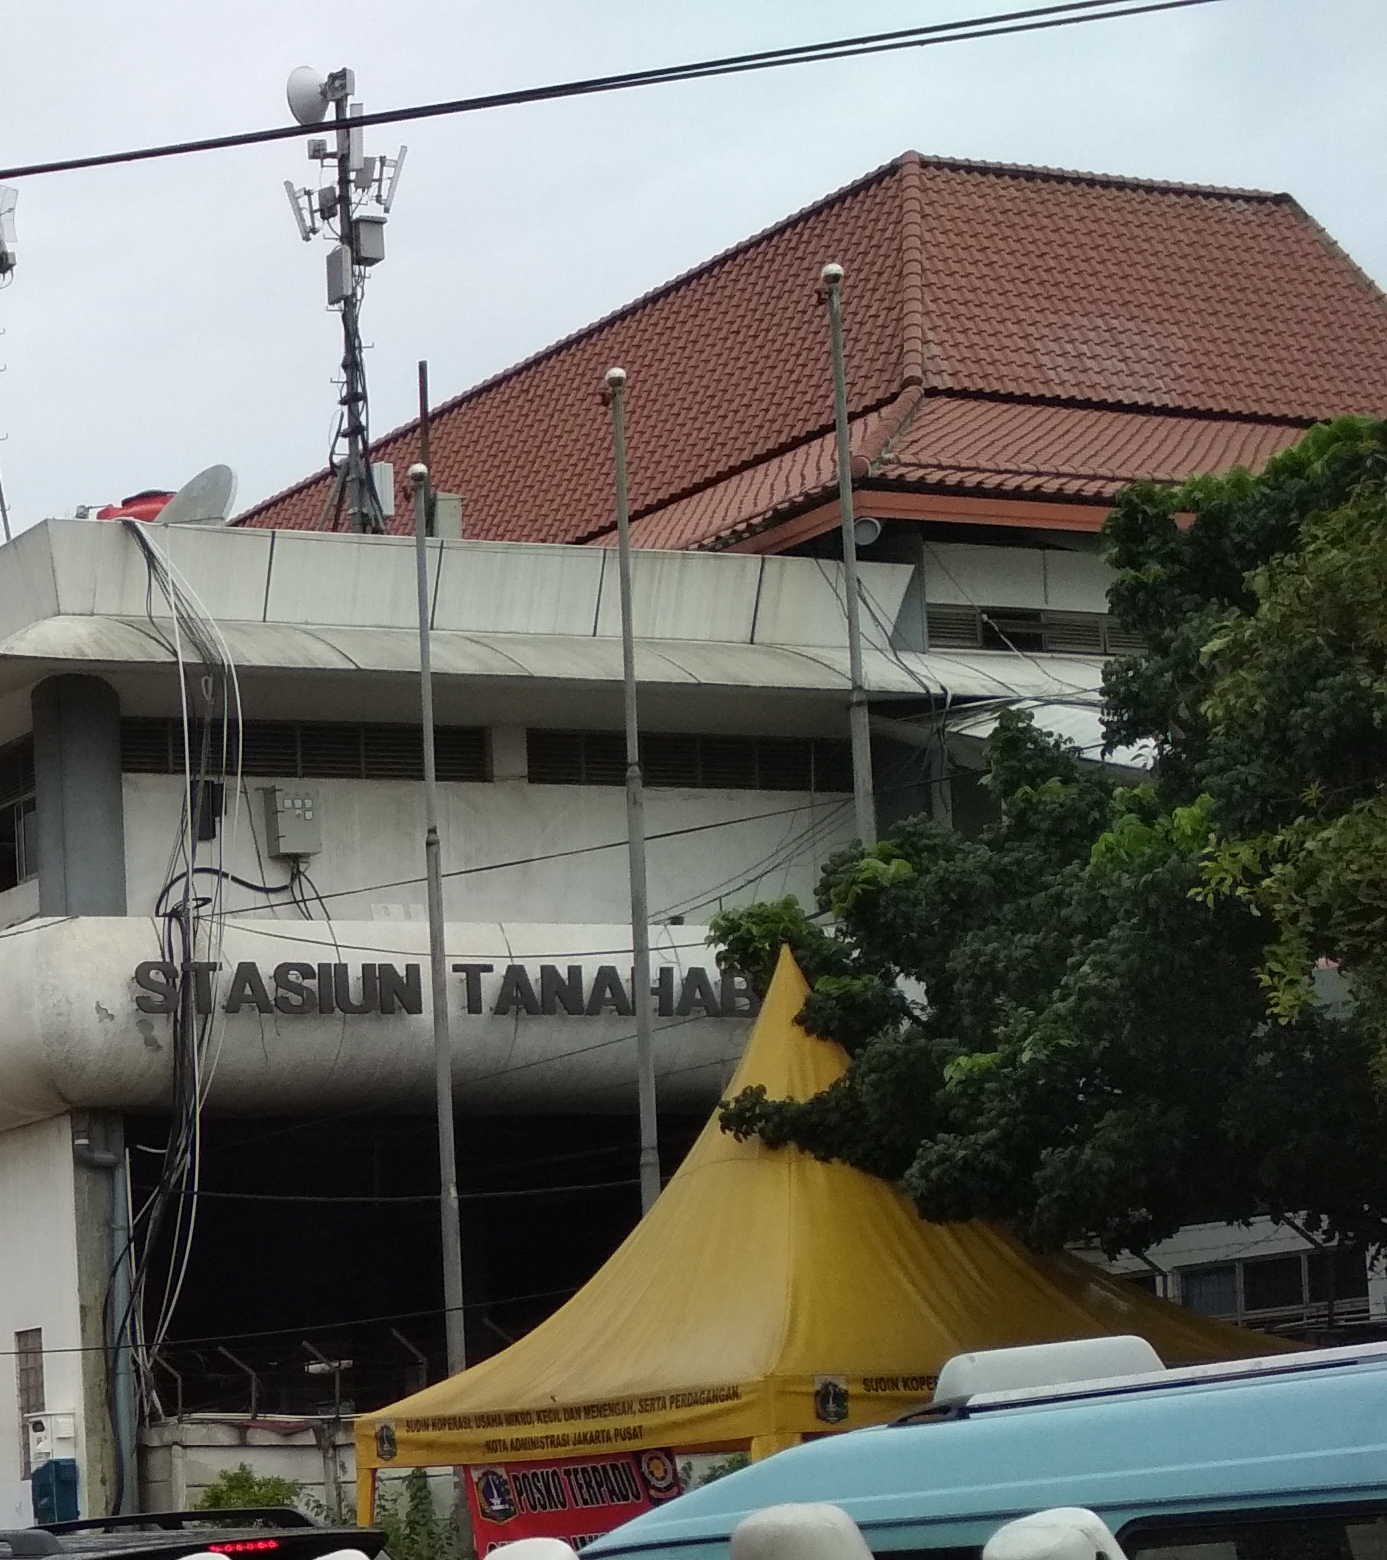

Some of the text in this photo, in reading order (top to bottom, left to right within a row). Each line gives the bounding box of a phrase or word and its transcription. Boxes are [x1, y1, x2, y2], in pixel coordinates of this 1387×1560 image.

[135, 961, 423, 1014] STASIUN
[863, 1376, 899, 1393] SUDIN
[405, 1418, 430, 1433] SUDIN
[475, 1413, 504, 1429] USAHA
[536, 1408, 563, 1424] KECIL
[563, 1406, 582, 1422] DAN
[638, 1396, 668, 1415] SERTA
[509, 1433, 572, 1452] ADMINISTRASI
[572, 1428, 613, 1447] JAKARTA
[614, 1424, 645, 1443] PUSAT
[511, 1460, 643, 1514] POSKO TERPADU
